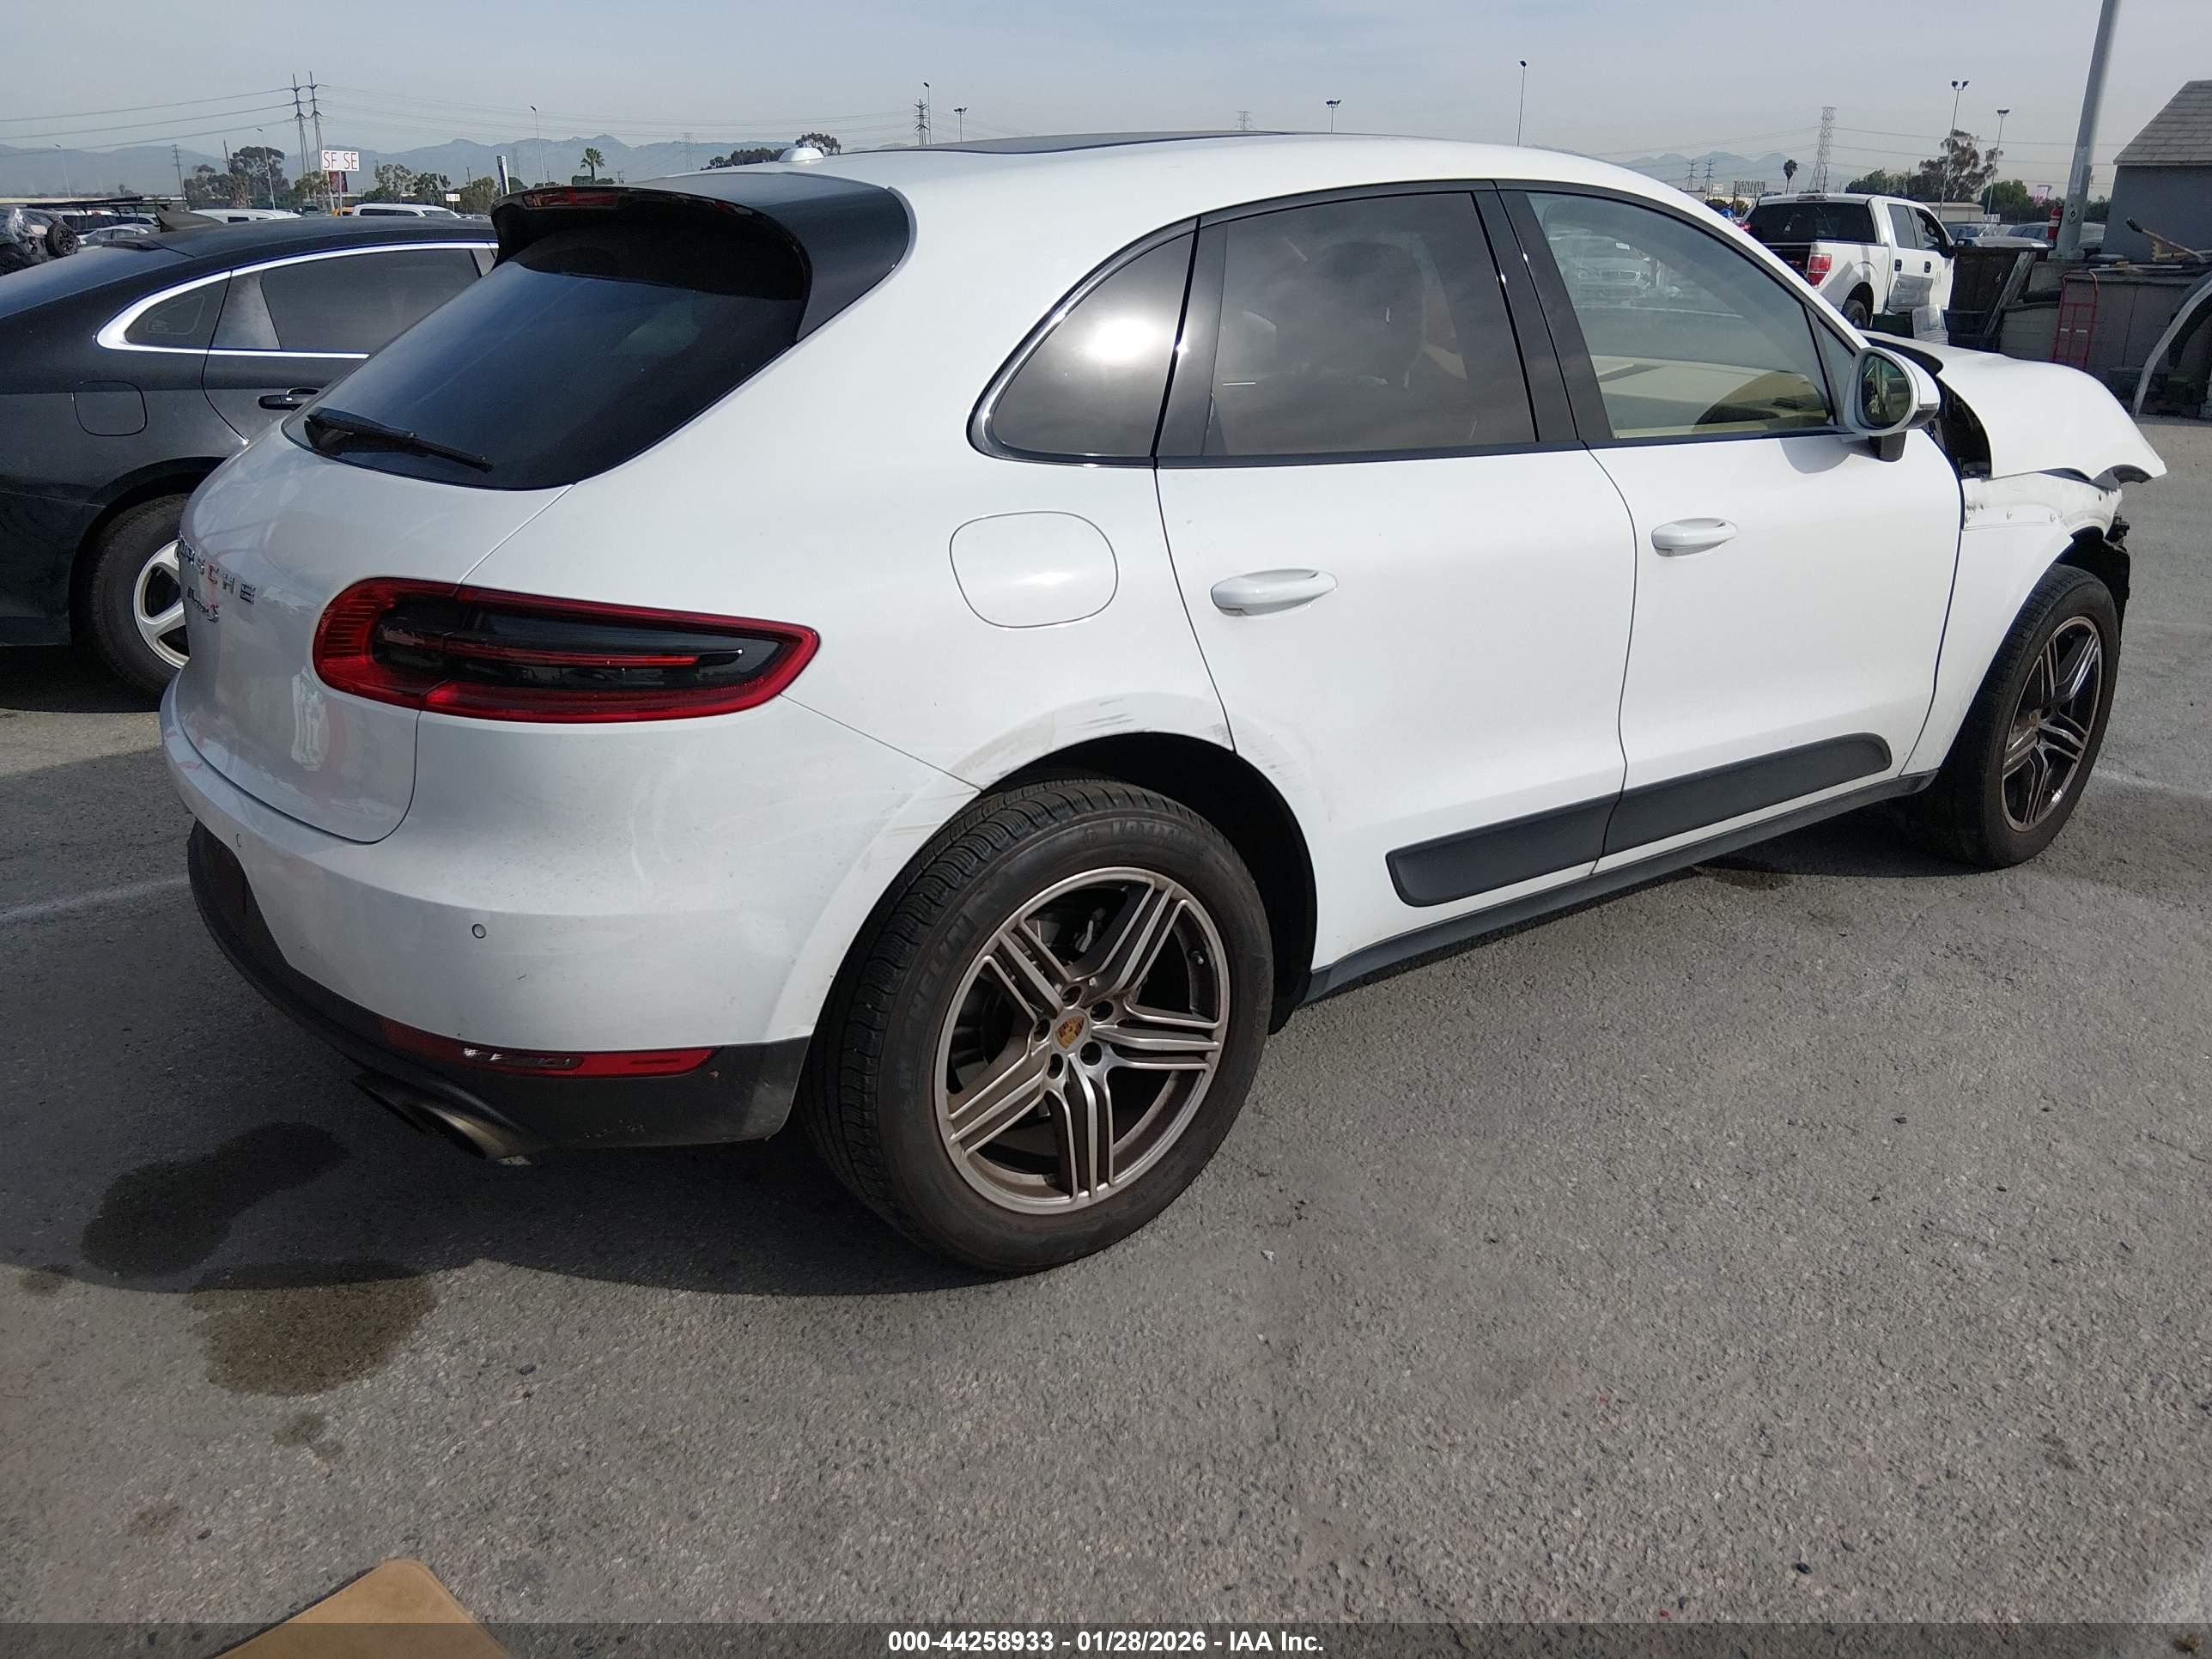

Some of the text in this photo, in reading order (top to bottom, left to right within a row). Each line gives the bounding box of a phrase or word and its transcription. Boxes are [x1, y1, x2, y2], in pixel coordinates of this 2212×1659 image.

[324, 151, 358, 172] SF SE
[2069, 209, 2076, 218] 6
